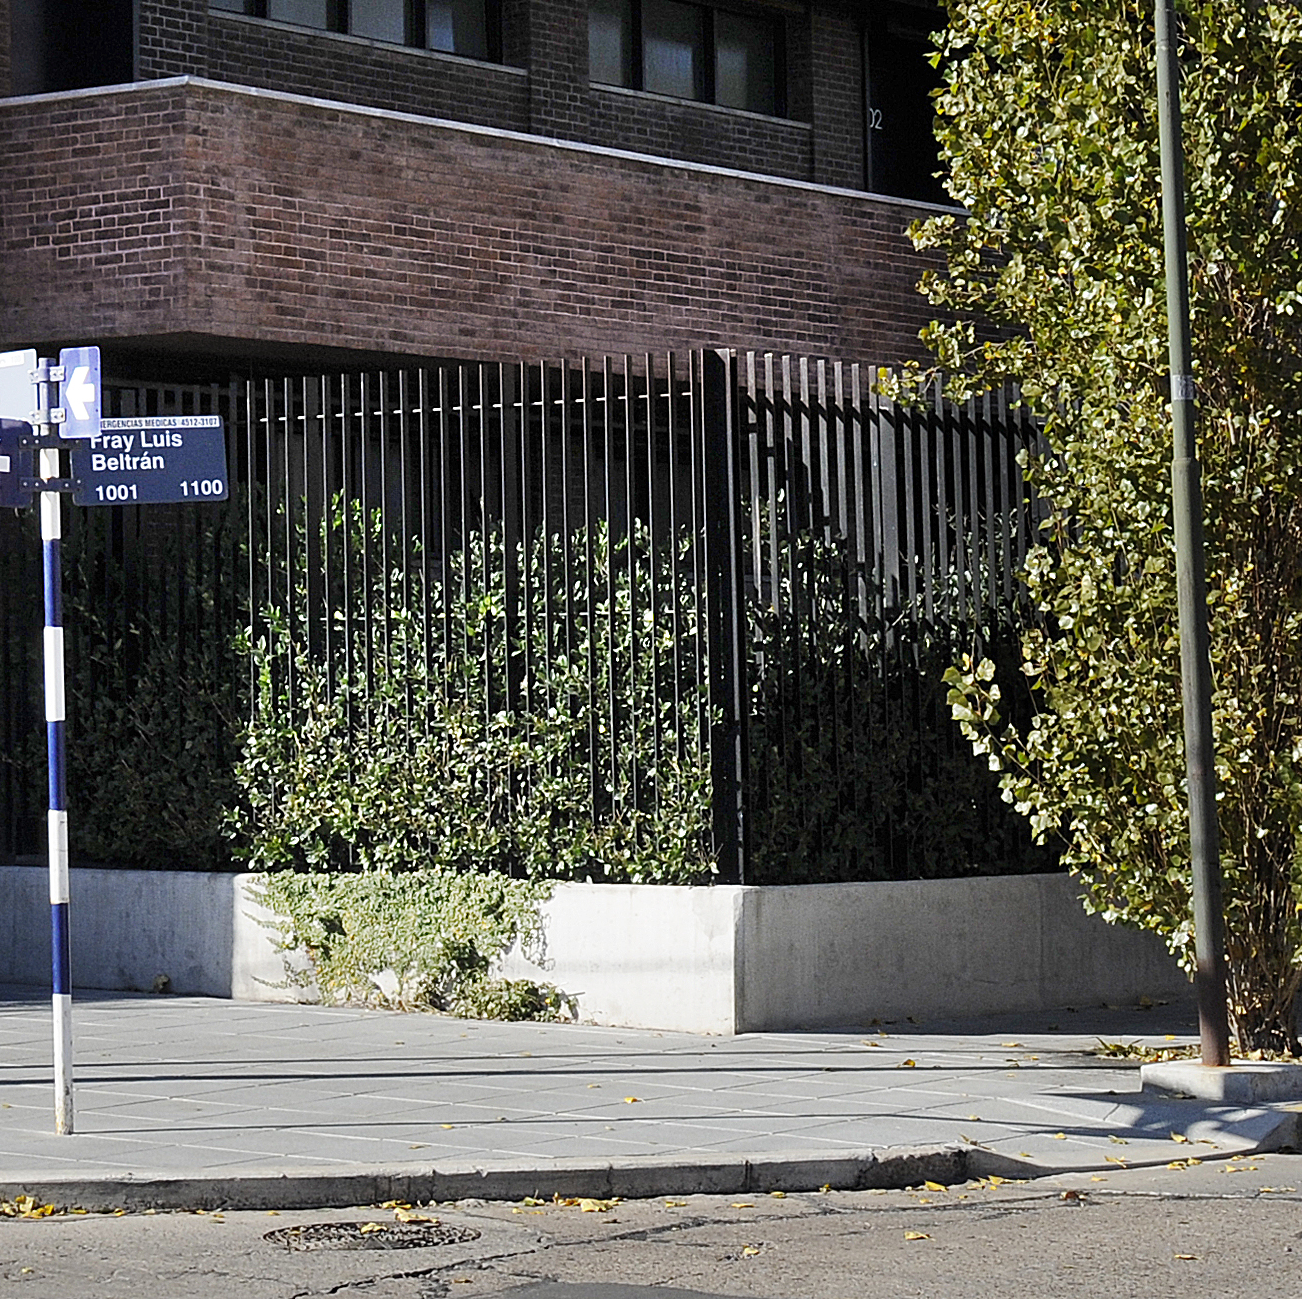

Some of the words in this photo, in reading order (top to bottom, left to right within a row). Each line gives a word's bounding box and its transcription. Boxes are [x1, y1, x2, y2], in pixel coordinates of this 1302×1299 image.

[101, 419, 143, 428] ERGENCIAS
[145, 418, 177, 428] MEDICAS
[90, 434, 134, 452] Fray
[140, 430, 183, 448] Luis
[91, 451, 165, 471] Beltrán
[95, 484, 138, 501] 1001
[179, 479, 223, 497] 1100
